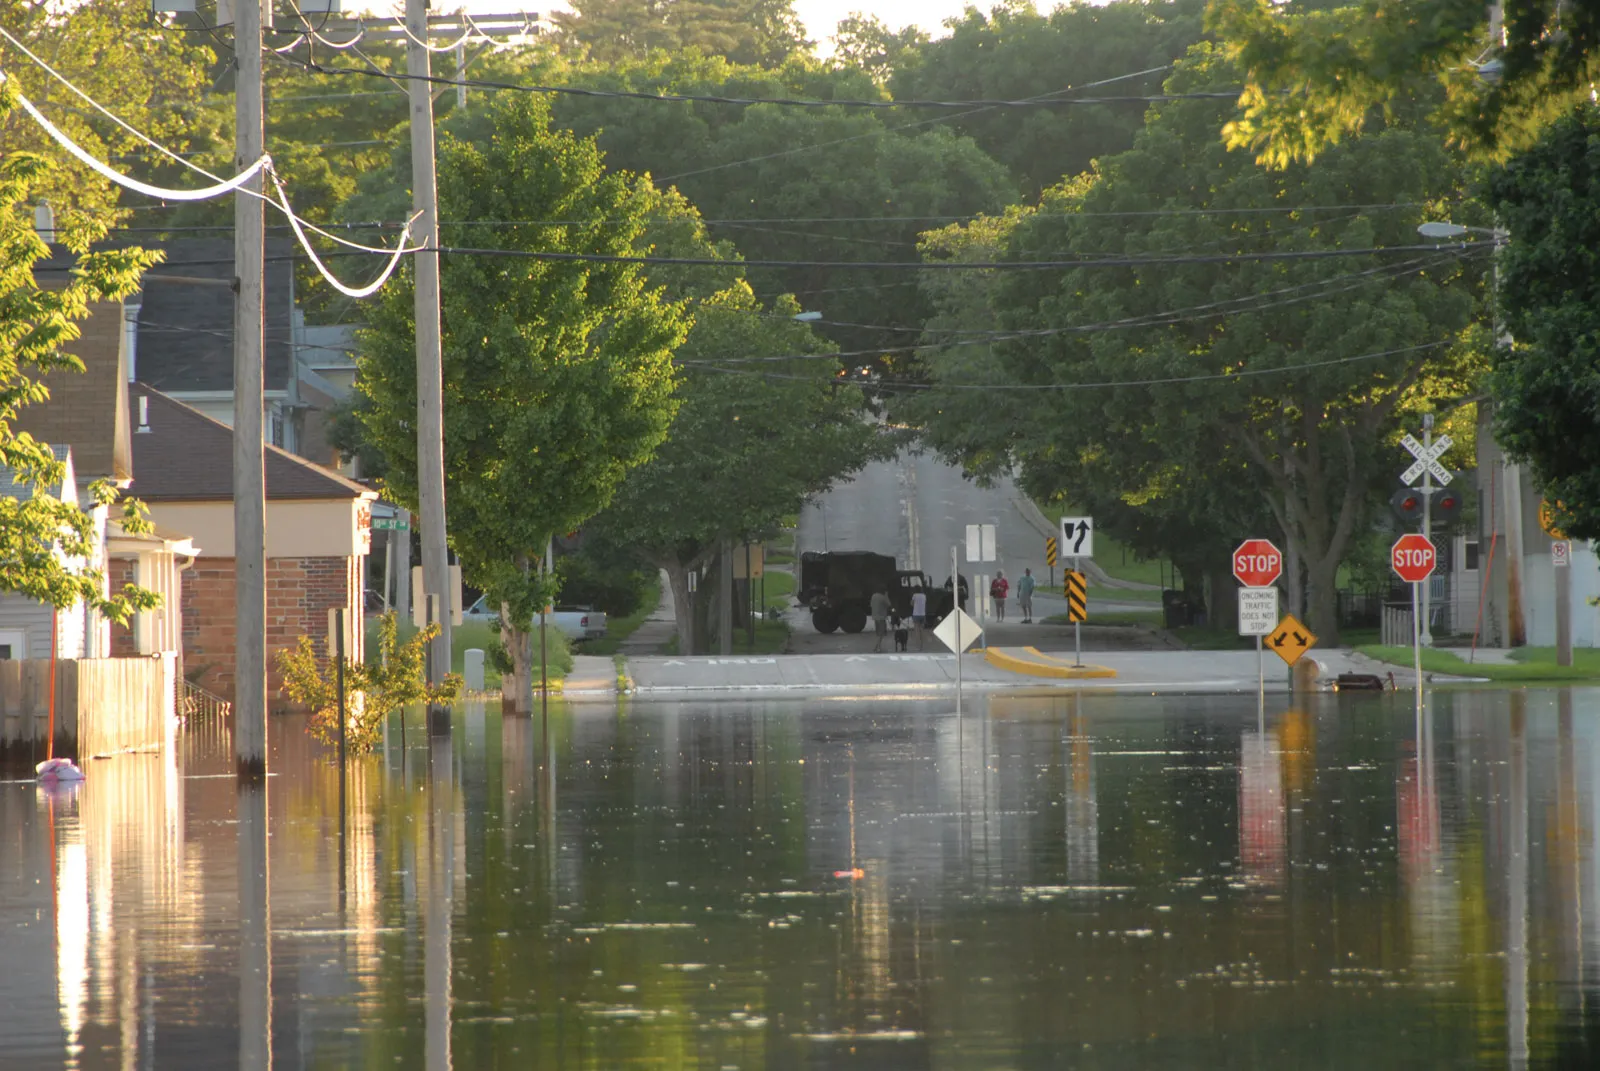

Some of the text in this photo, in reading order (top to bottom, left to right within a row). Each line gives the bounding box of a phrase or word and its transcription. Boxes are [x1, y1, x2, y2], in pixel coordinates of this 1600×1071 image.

[1395, 549, 1433, 567] STOP
[1237, 555, 1278, 572] STOP
[1241, 591, 1275, 600] ONCOMING
[1241, 612, 1275, 620] DOES NOT
[1250, 622, 1268, 630] STOP
